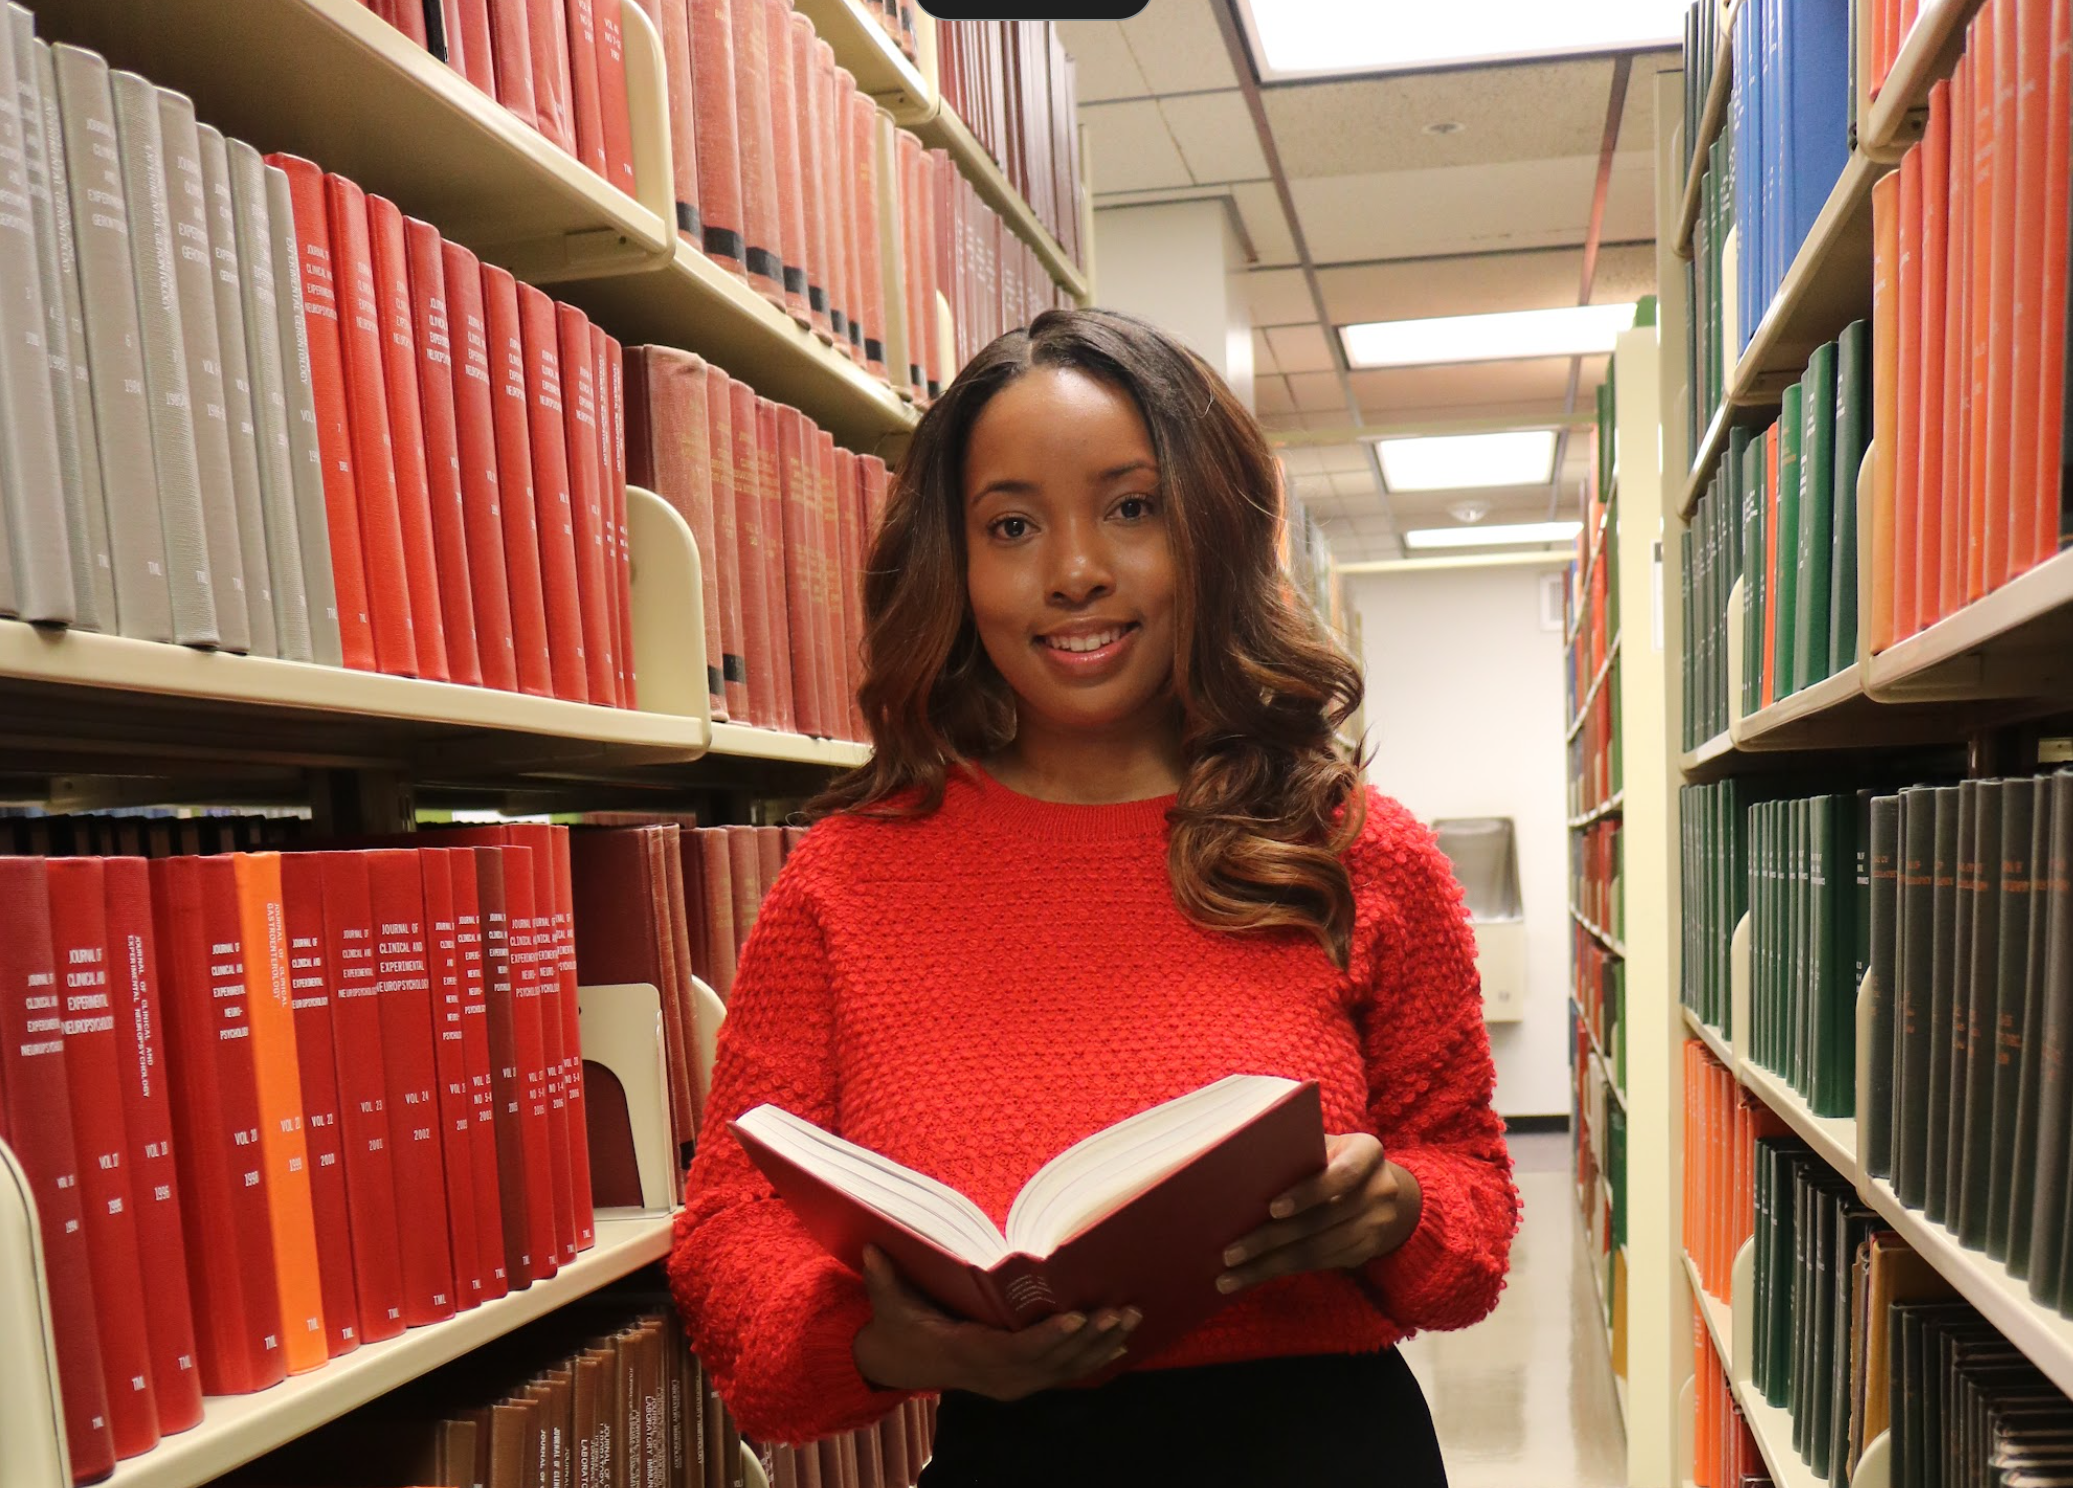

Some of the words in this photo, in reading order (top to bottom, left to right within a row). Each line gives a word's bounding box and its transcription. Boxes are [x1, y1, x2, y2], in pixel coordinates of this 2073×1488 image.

[274, 903, 283, 942] JOURNAL
[459, 916, 475, 925] JOURNAL
[512, 918, 531, 929] JOURNAL
[343, 929, 363, 939] JOURNAL
[382, 923, 409, 935] JOURNAL
[411, 923, 419, 934] OF
[292, 939, 312, 949] JOURNAL
[457, 934, 476, 943] CLINICAL
[510, 936, 532, 947] CLINICAL
[212, 943, 235, 955] JOURNAL
[266, 902, 280, 1000] GASTROENTEROLOGY
[278, 948, 285, 960] OF
[342, 949, 363, 959] CLINICAL
[379, 942, 410, 954] CLINICAL
[412, 942, 423, 952] AND
[135, 936, 145, 975] JOURNAL
[291, 958, 313, 969] CLINICAL
[380, 960, 425, 973] EXPERIMENTAL
[211, 965, 235, 976] CLINICAL
[343, 968, 374, 979] EXPERIMENTAL
[67, 973, 96, 988] CLINICAL
[139, 980, 147, 992] OF
[292, 977, 324, 989] EXPERIMENTAL
[279, 966, 288, 1008] CLINICAL
[127, 935, 140, 1002] EXPERIMENTAL
[134, 1008, 150, 1098] NEUROPSYCHOLOGY
[141, 999, 151, 1041] CLINICAL
[146, 1046, 154, 1066] AND
[563, 1058, 571, 1067] VOL
[528, 1072, 538, 1082] VOL
[547, 1067, 557, 1077] VOL
[473, 1076, 484, 1086] VOL
[449, 1084, 460, 1095] VOL
[549, 1084, 556, 1093] NO
[405, 1093, 422, 1105] VOL
[422, 1091, 430, 1102] 24
[474, 1094, 483, 1104] NO
[553, 1099, 564, 1109] 2006
[360, 1102, 376, 1113] VOL
[376, 1100, 383, 1111] 23
[280, 1118, 294, 1133] VOL
[311, 1116, 327, 1128] VOL
[326, 1114, 334, 1126] 22
[234, 1132, 249, 1147] VOL
[413, 1128, 430, 1141] 2002
[369, 1138, 384, 1151] 2001
[145, 1144, 159, 1158] VOL
[99, 1156, 111, 1170] VOL
[320, 1153, 335, 1167] 2000
[433, 1293, 447, 1306] TML
[388, 1308, 400, 1320] TML
[342, 1328, 354, 1340] TML
[264, 1335, 278, 1350] TML
[645, 1395, 653, 1455] LABORATORY
[553, 1460, 560, 1468] OF
[539, 1471, 546, 1482] OF
[603, 1468, 610, 1480] OF
